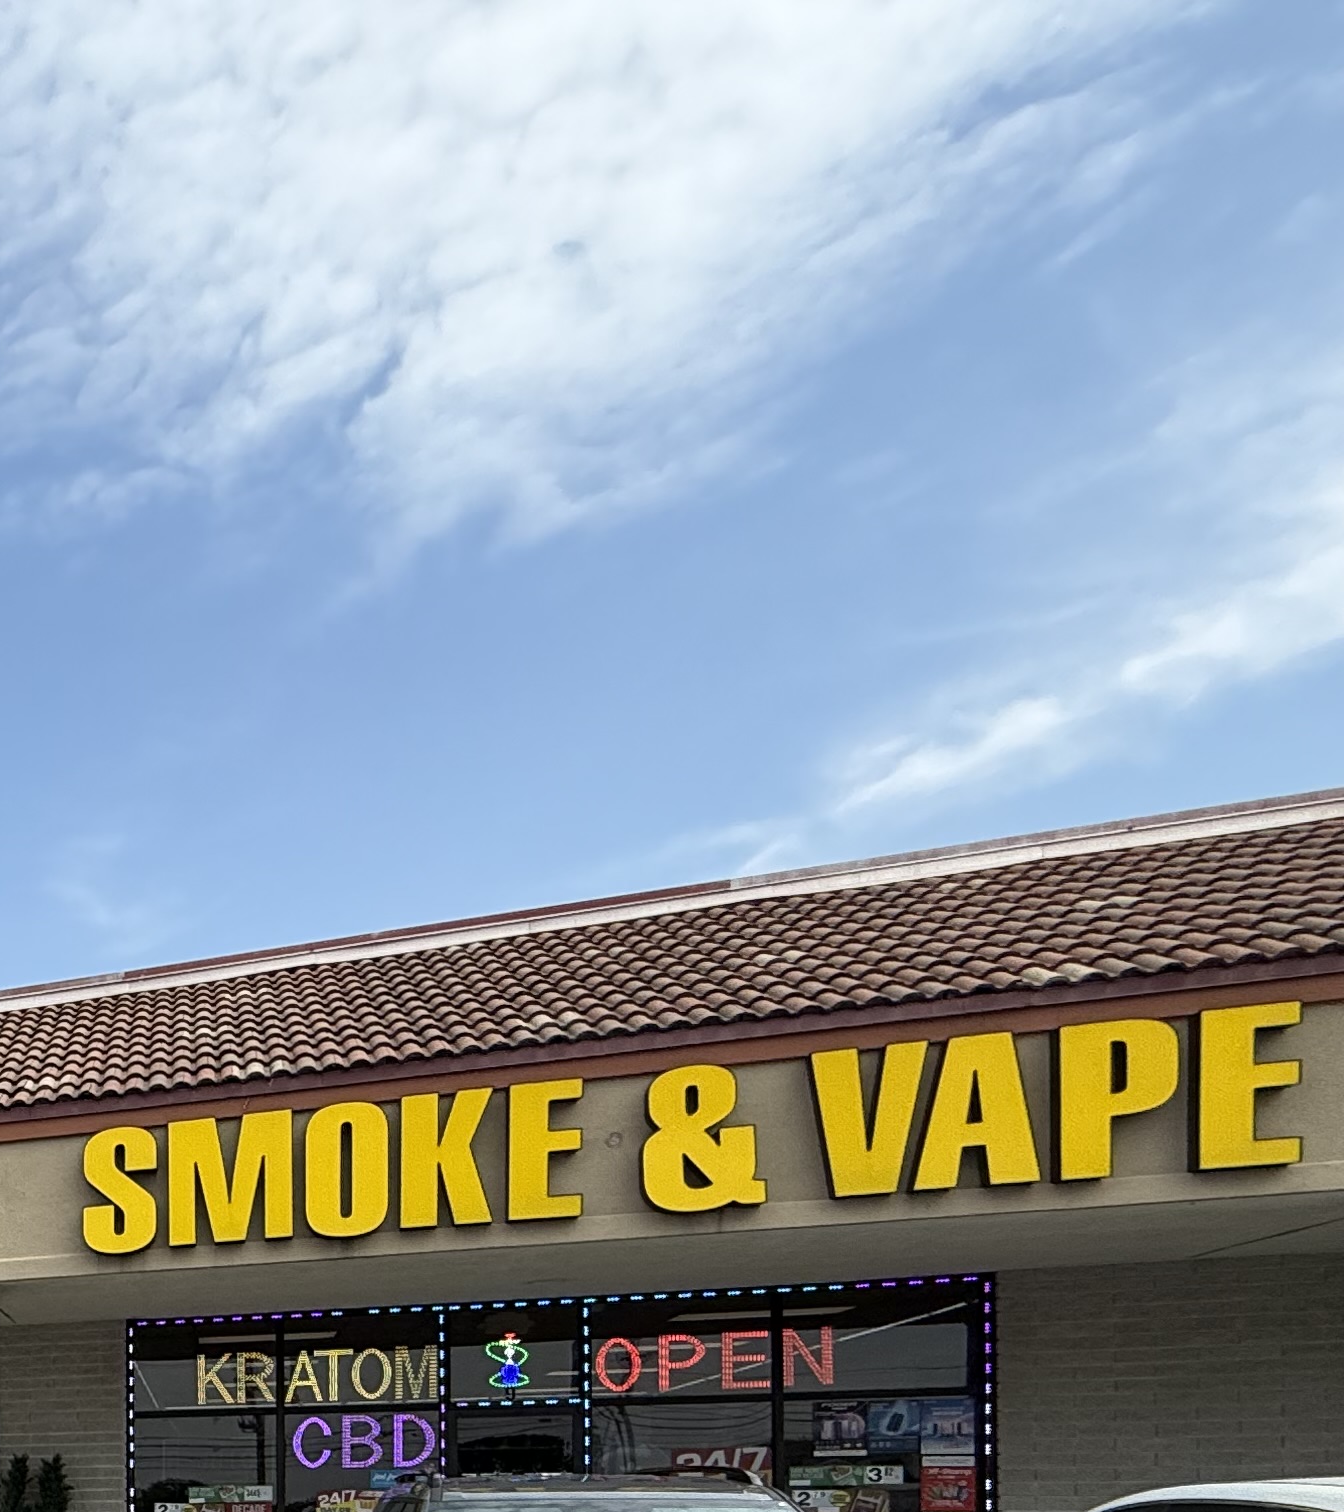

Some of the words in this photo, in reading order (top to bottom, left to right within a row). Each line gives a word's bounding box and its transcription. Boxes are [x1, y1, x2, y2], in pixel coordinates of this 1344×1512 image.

[82, 1079, 583, 1255] SMOKE
[642, 1064, 768, 1213] &
[810, 1001, 1304, 1198] VAPE
[197, 1345, 438, 1405] KRATOM
[595, 1325, 835, 1393] OPEN
[293, 1414, 436, 1469] CBD
[798, 1491, 811, 1507] 2
[868, 1468, 882, 1482] 3
